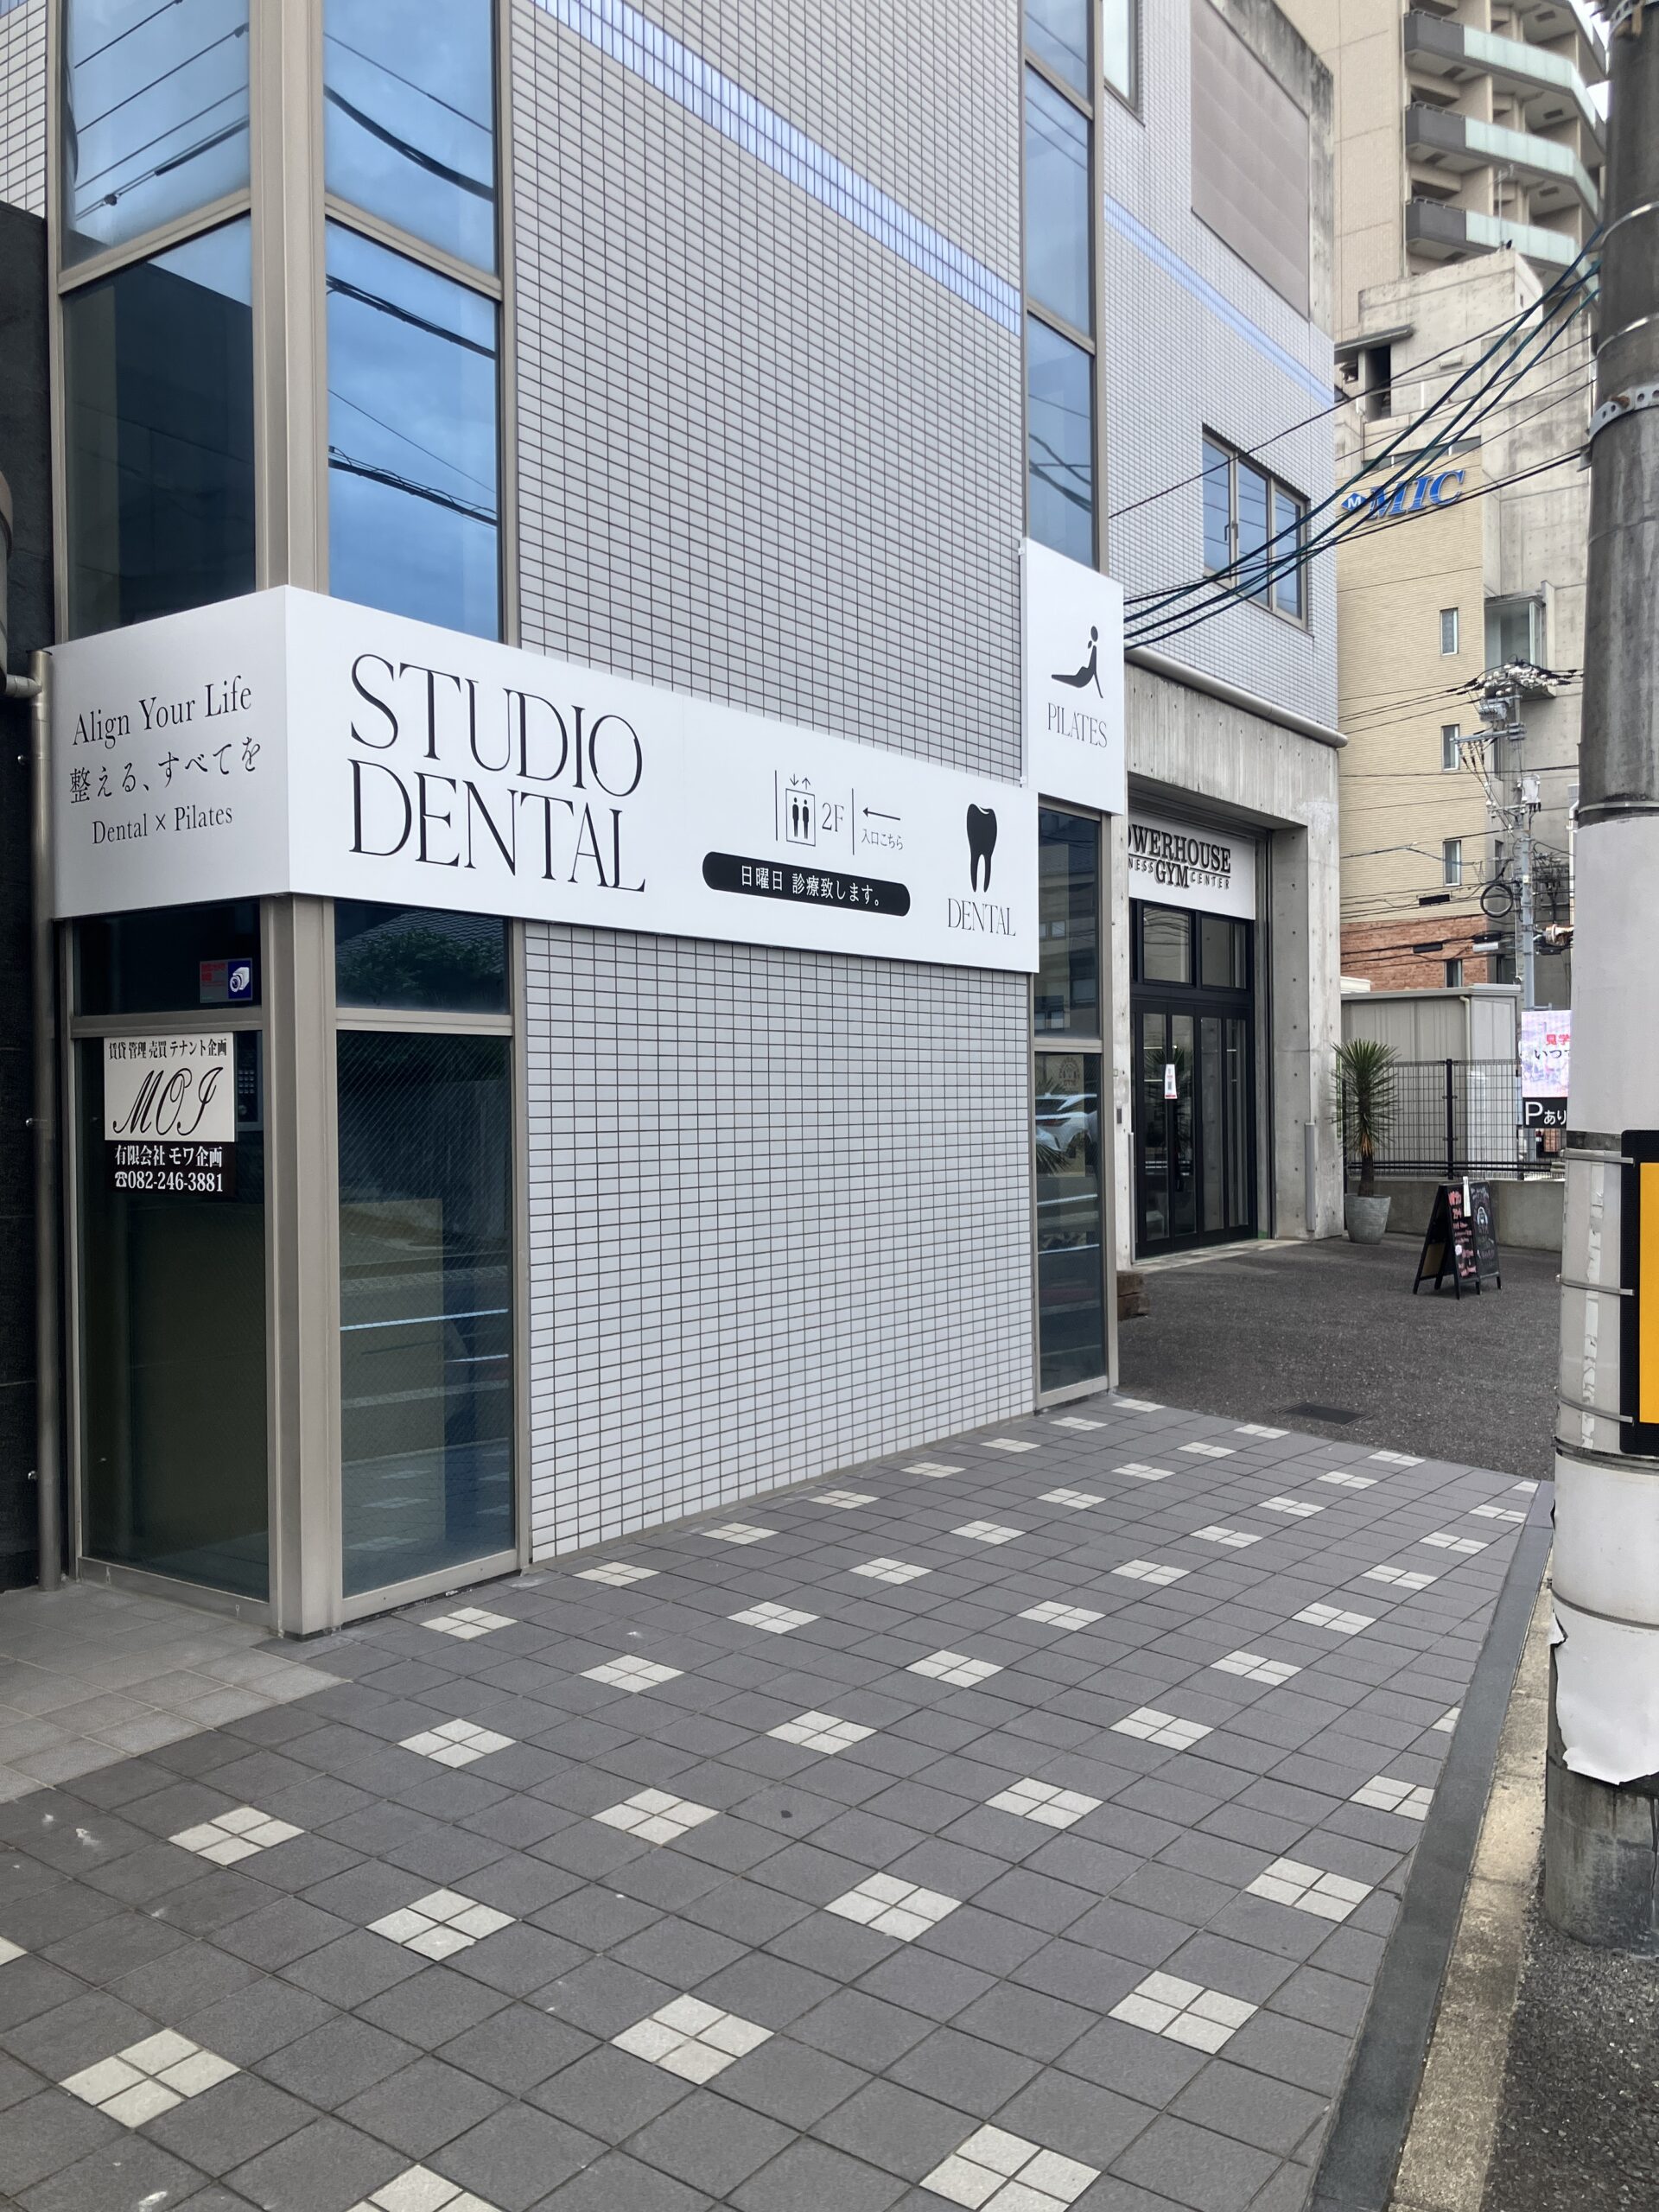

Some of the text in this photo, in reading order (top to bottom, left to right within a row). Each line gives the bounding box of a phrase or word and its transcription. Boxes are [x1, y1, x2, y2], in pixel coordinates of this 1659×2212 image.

[1368, 469, 1465, 520] MIC
[73, 675, 252, 749] Align Your Life
[350, 653, 643, 797] STUDIO
[1047, 702, 1108, 748] PILATES
[69, 736, 261, 804] 整える、すべてを
[92, 813, 148, 844] Dental
[174, 804, 232, 831] Pilates
[346, 758, 646, 893] DENTAL
[822, 802, 844, 833] 2F
[861, 828, 904, 851] 入口こちら
[1128, 823, 1231, 874] WERHOUSE
[741, 865, 880, 906] 日曜日 診療致します。
[1154, 860, 1190, 888] GYM
[1190, 871, 1230, 890] CENTER
[948, 898, 1016, 937] DENTAL
[128, 1041, 147, 1059] 管理
[149, 1040, 167, 1059] 売買
[169, 1038, 227, 1058] テナント企画
[115, 1145, 223, 1167] 有限会社 モワ企画
[128, 1170, 223, 1192] 082-246-3881
